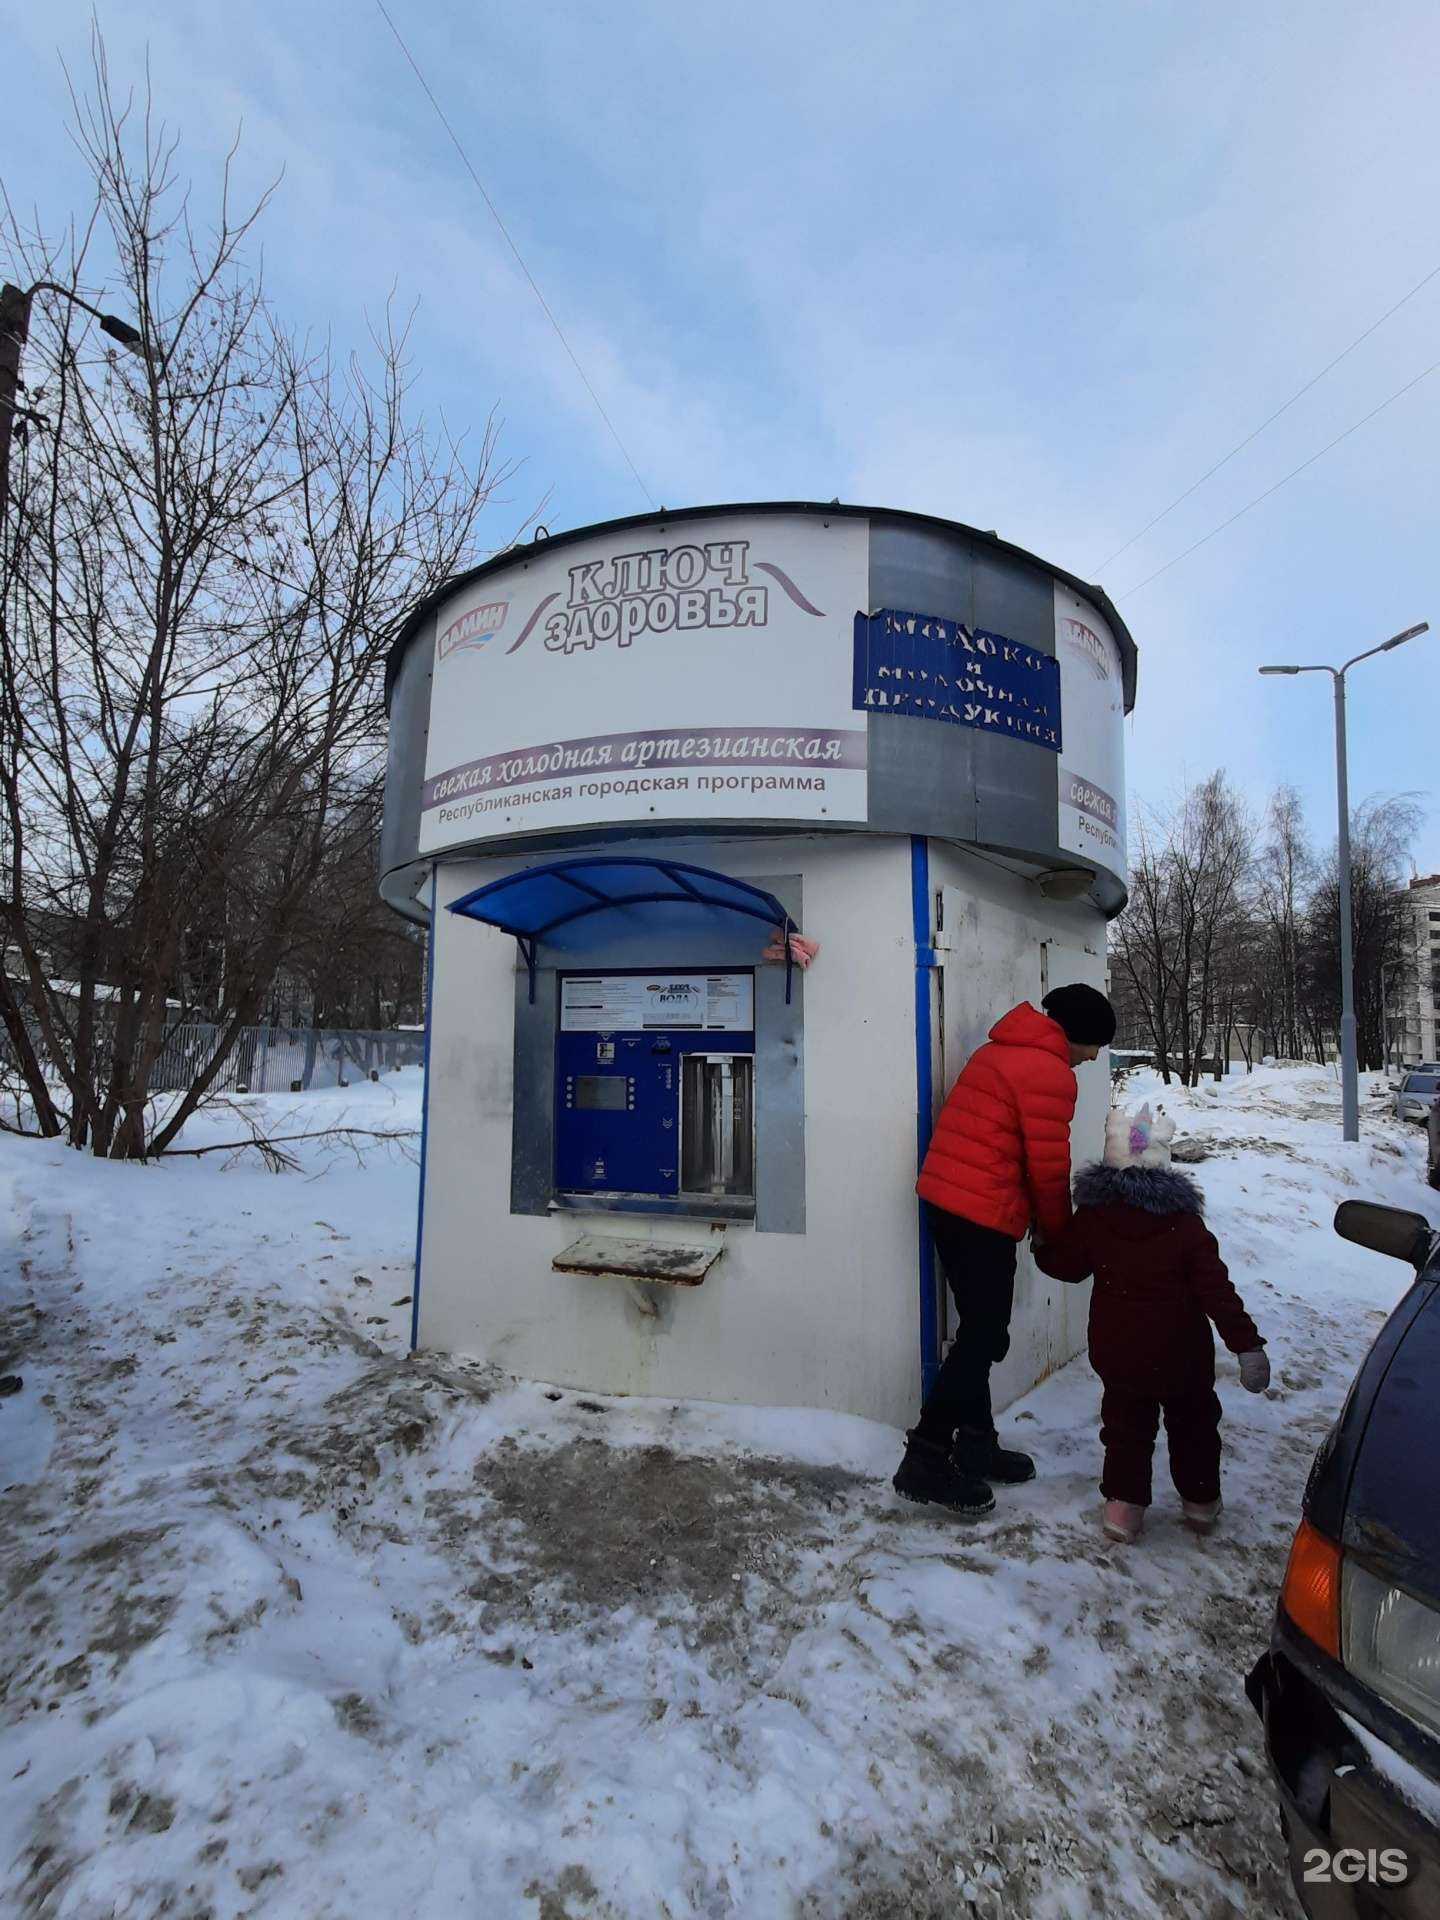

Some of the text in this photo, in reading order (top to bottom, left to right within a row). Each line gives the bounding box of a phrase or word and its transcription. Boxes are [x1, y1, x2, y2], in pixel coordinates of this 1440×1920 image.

[567, 541, 750, 609] КЛЮЧ
[433, 735, 843, 801] свежая холодная артезианская
[438, 774, 826, 824] Республиканская городская программа
